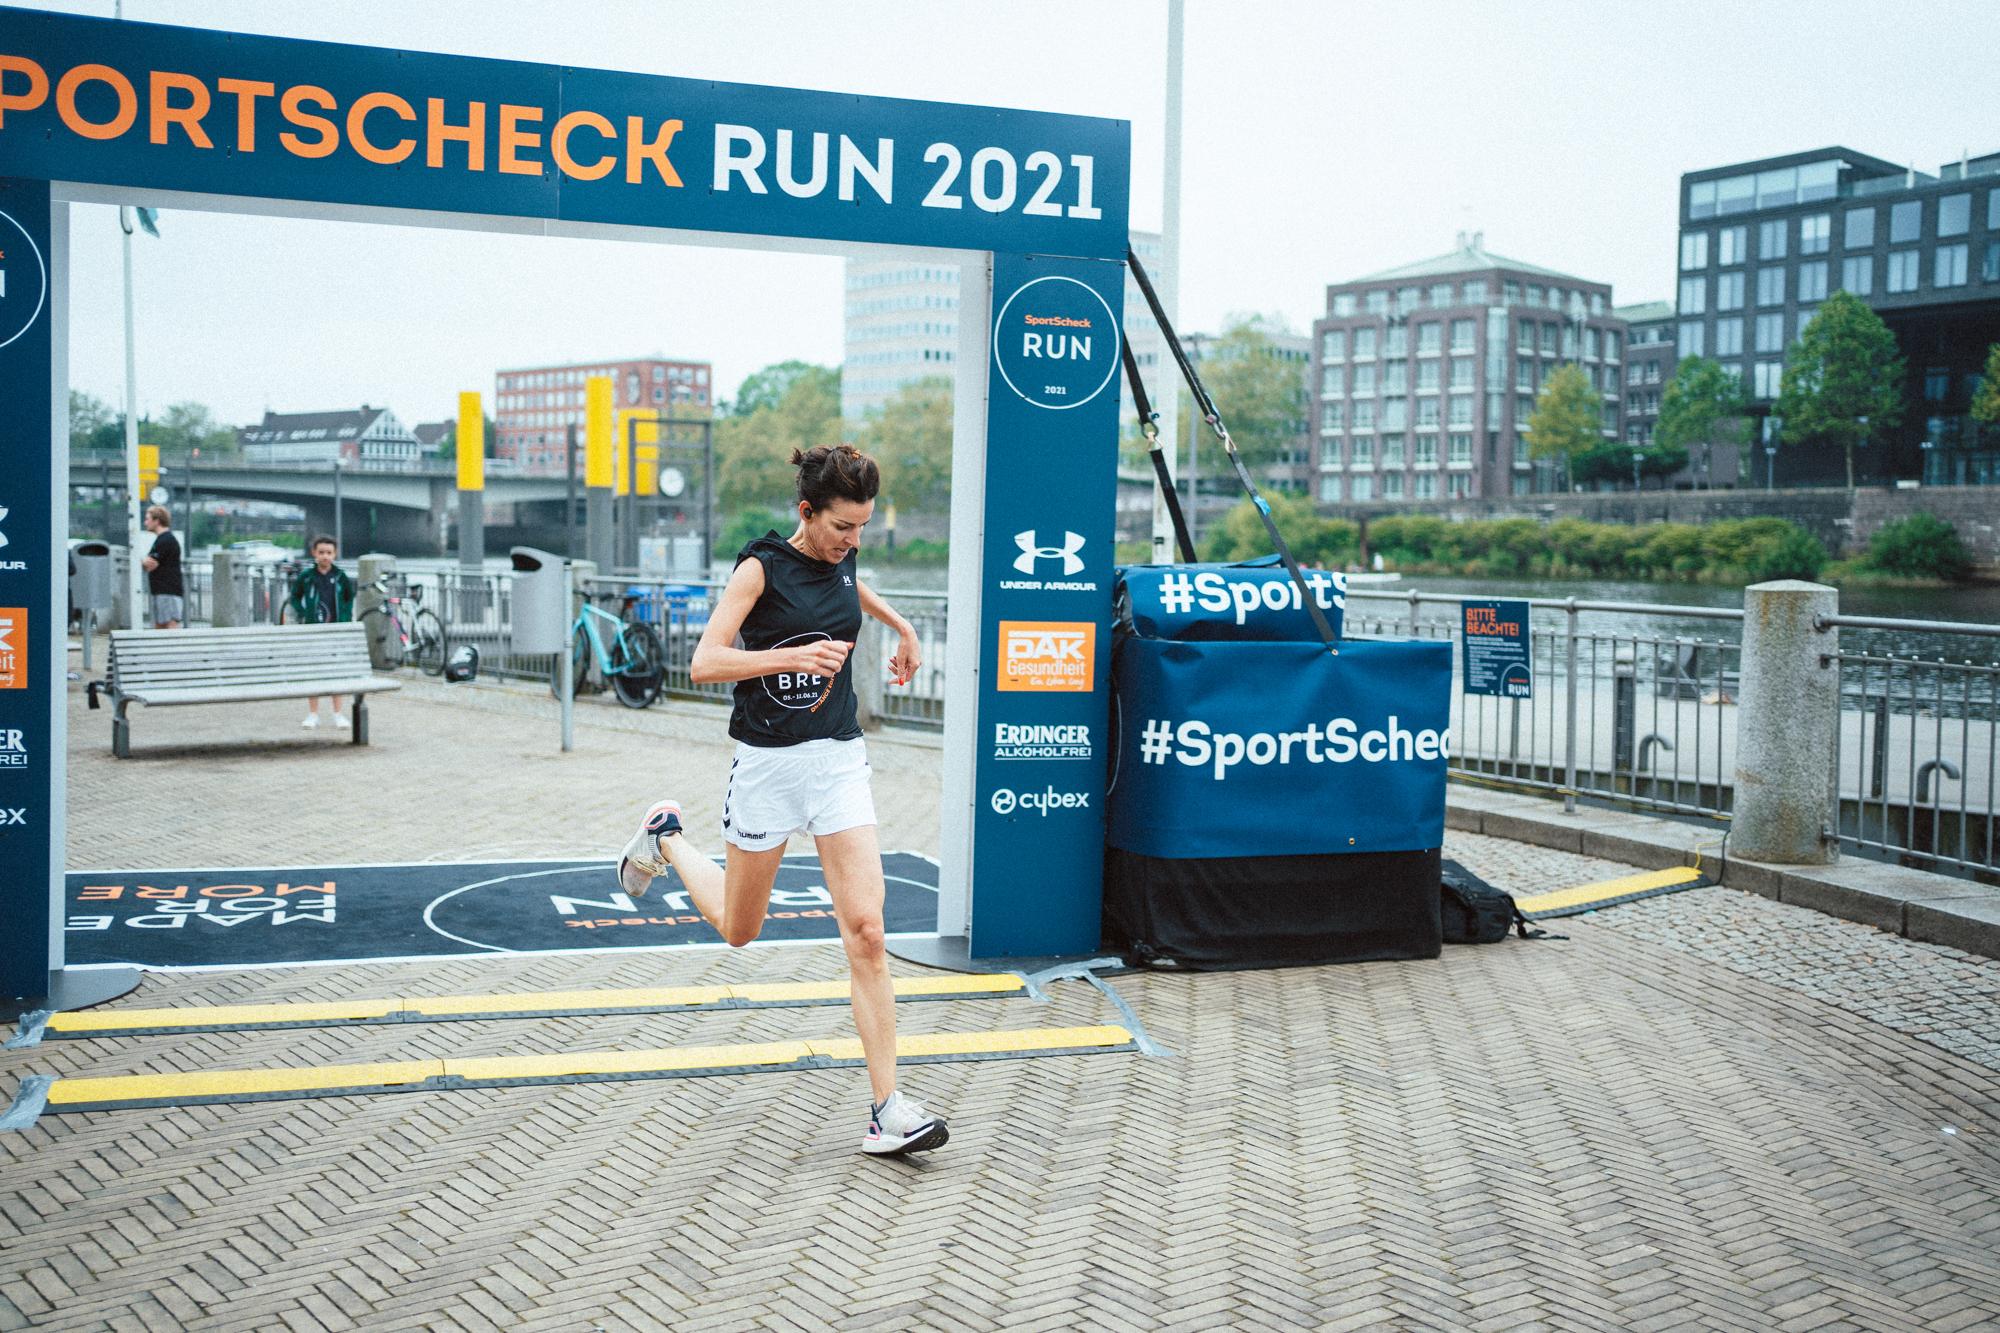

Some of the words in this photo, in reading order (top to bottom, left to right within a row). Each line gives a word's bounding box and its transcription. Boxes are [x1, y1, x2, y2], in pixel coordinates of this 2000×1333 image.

[712, 123, 894, 205] RUN
[921, 141, 1103, 221] 2021
[1025, 314, 1091, 328] SportScheck
[1023, 332, 1092, 361] RUN
[1045, 386, 1066, 395] 2021
[1000, 581, 1042, 590] UNDER
[1044, 581, 1098, 591] ARMOUR
[1467, 608, 1496, 621] BITTE
[1467, 621, 1519, 636] BEACHTE!
[1008, 631, 1086, 659] DAK
[1007, 658, 1086, 675] Gesundheit
[778, 672, 821, 690] BRE
[1508, 684, 1529, 696] RUN
[995, 723, 1091, 747] ERDINGER
[994, 746, 1092, 758] ALKOHOLFREI
[1019, 785, 1090, 817] cybex
[737, 828, 767, 840] hummel
[77, 881, 337, 901] MORE
[154, 894, 337, 914] FOR
[64, 908, 337, 931] MADE
